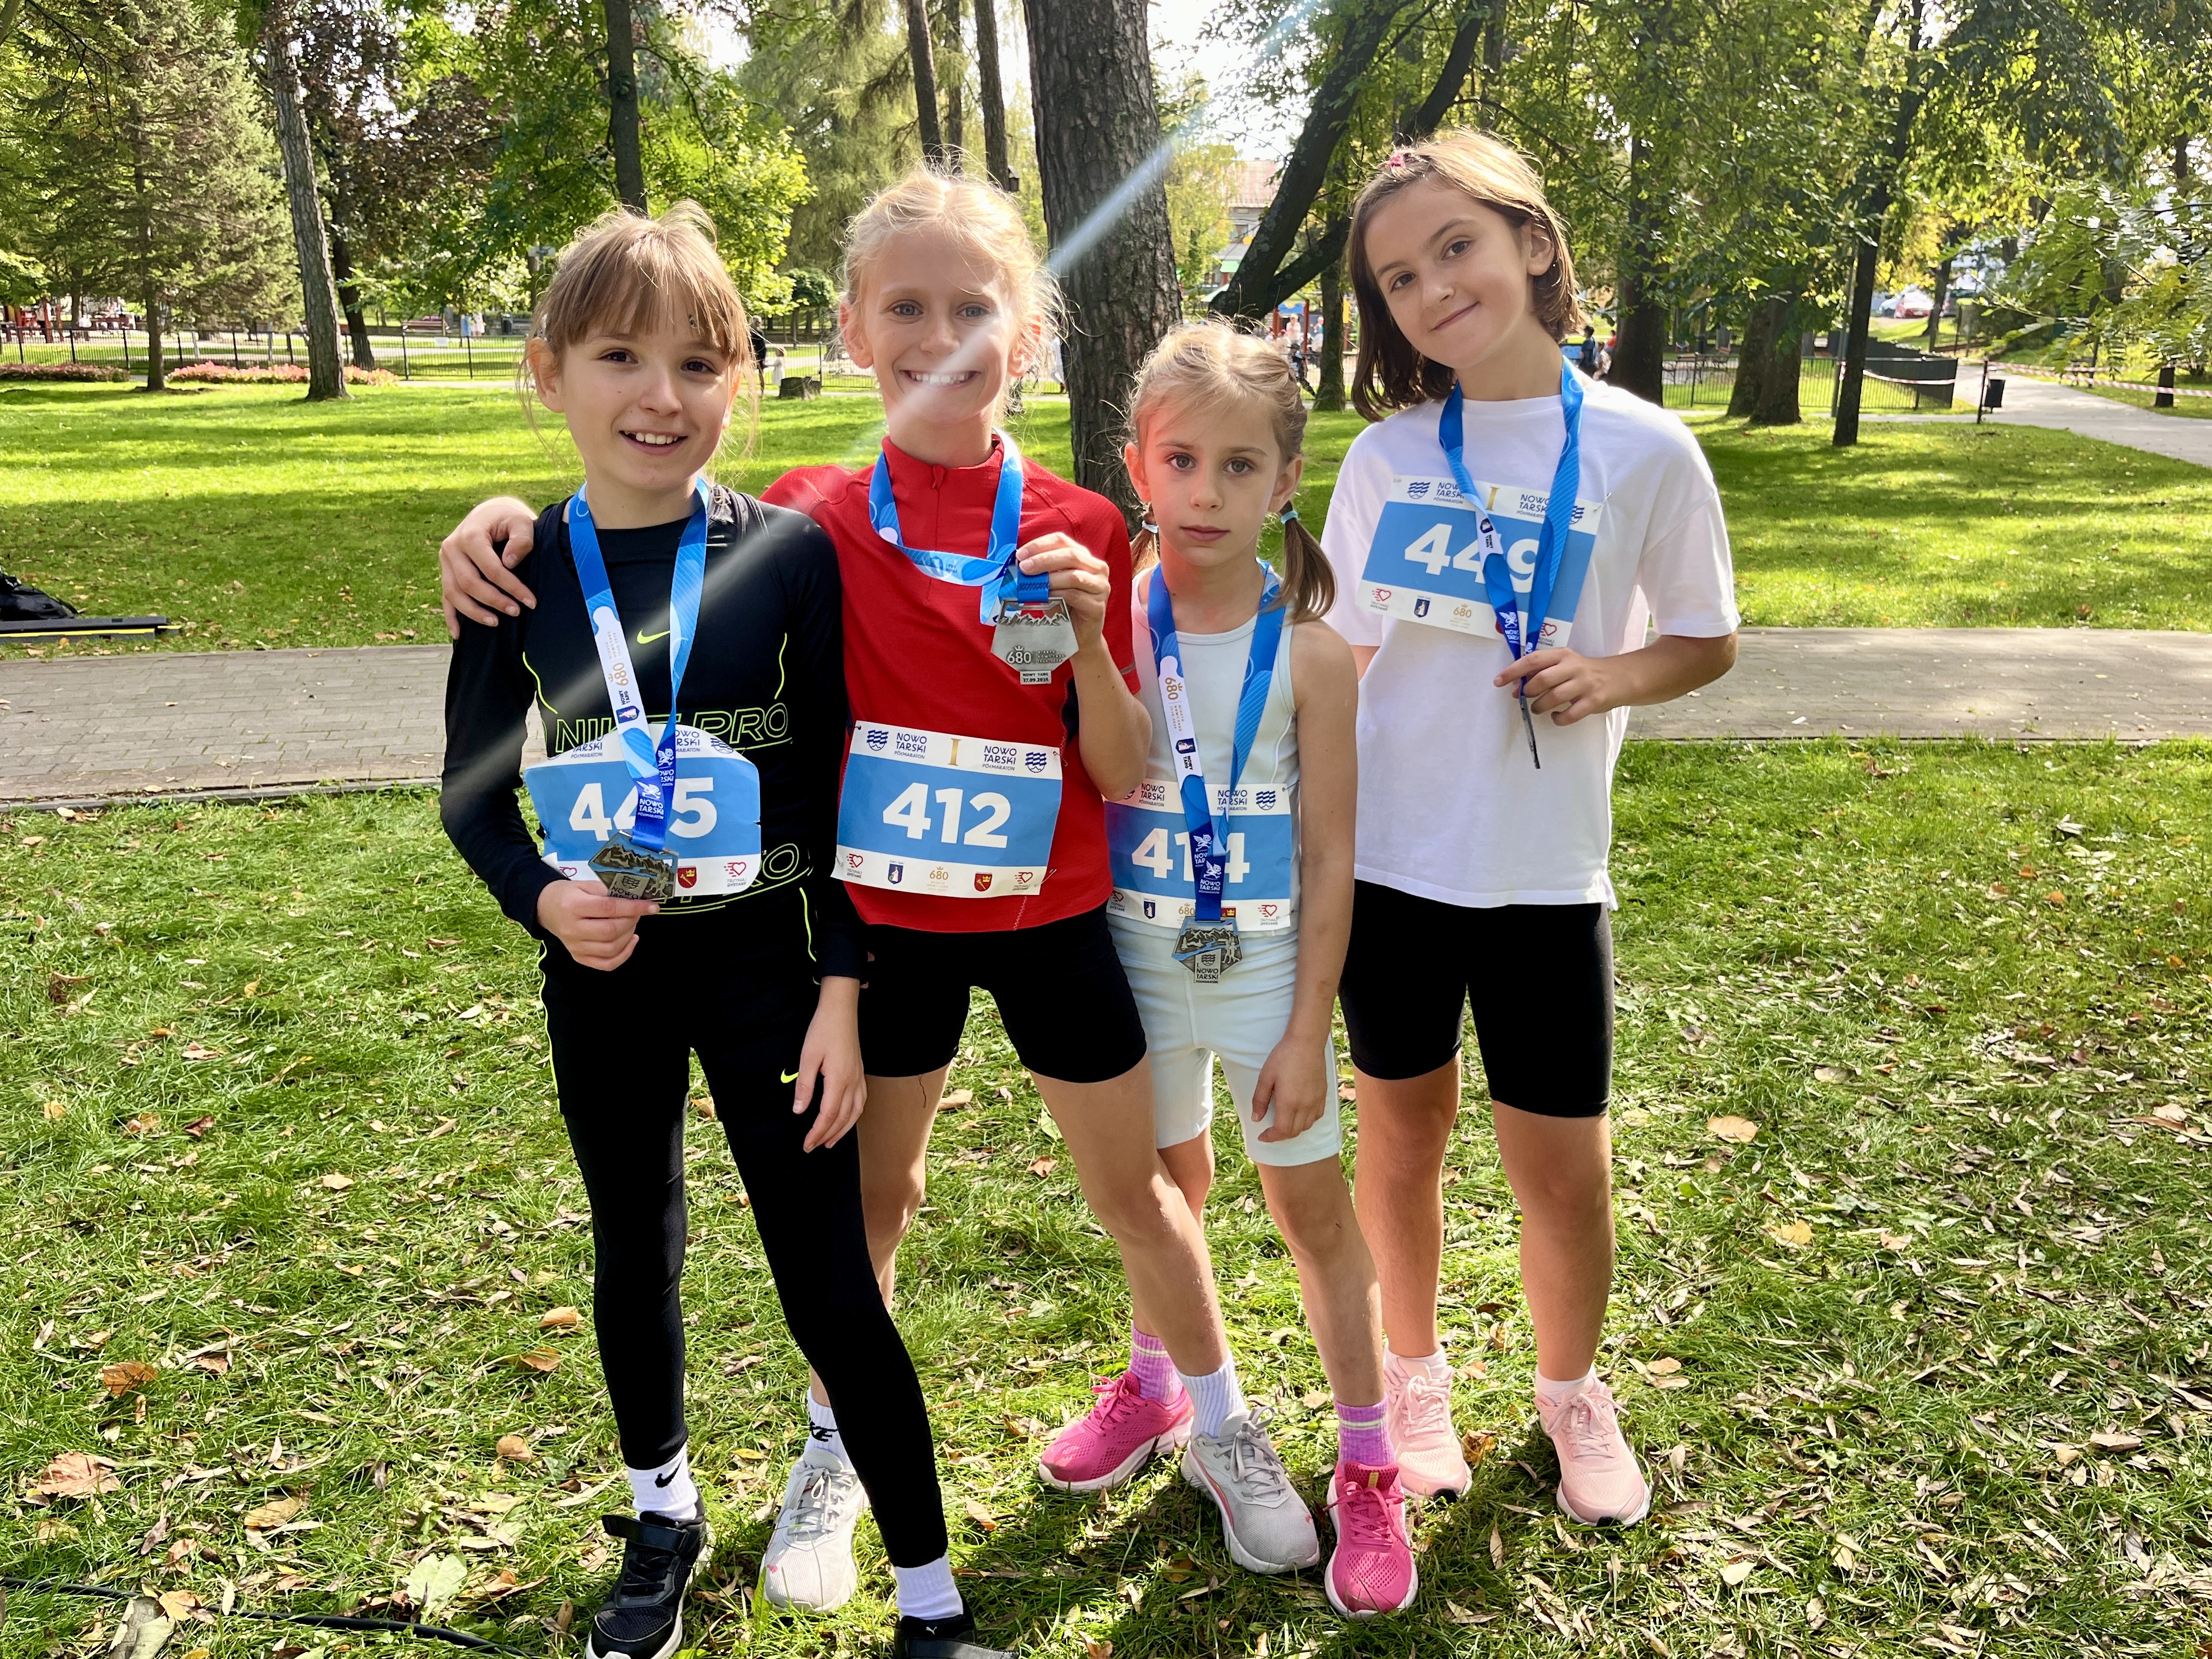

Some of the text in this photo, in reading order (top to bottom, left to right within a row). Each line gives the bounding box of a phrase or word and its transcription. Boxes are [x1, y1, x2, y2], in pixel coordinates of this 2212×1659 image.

[1437, 482, 1459, 490] NOW
[1436, 490, 1464, 498] TARSK
[1520, 502, 1548, 512] TARSK
[1517, 510, 1544, 518] PÓŁMARATO
[1453, 607, 1472, 618] 680
[1007, 651, 1031, 663] 680
[613, 662, 629, 686] 680
[1165, 677, 1178, 701] 680
[692, 702, 789, 745] PRO
[676, 730, 699, 738] OWO
[896, 733, 927, 745] NOWO
[676, 738, 701, 746] RSKI
[896, 741, 926, 753] TARSKI
[947, 738, 963, 766] I
[984, 745, 1017, 756] NOWO
[983, 754, 1016, 765] TARSKI
[1141, 783, 1165, 793] NOWO
[1141, 790, 1165, 802] TARSKI
[639, 799, 663, 809] NOWO
[639, 805, 664, 816] TARSKI
[883, 782, 1011, 849] 412
[1131, 827, 1250, 883] 414
[929, 870, 949, 880] 680
[1178, 906, 1195, 916] 680
